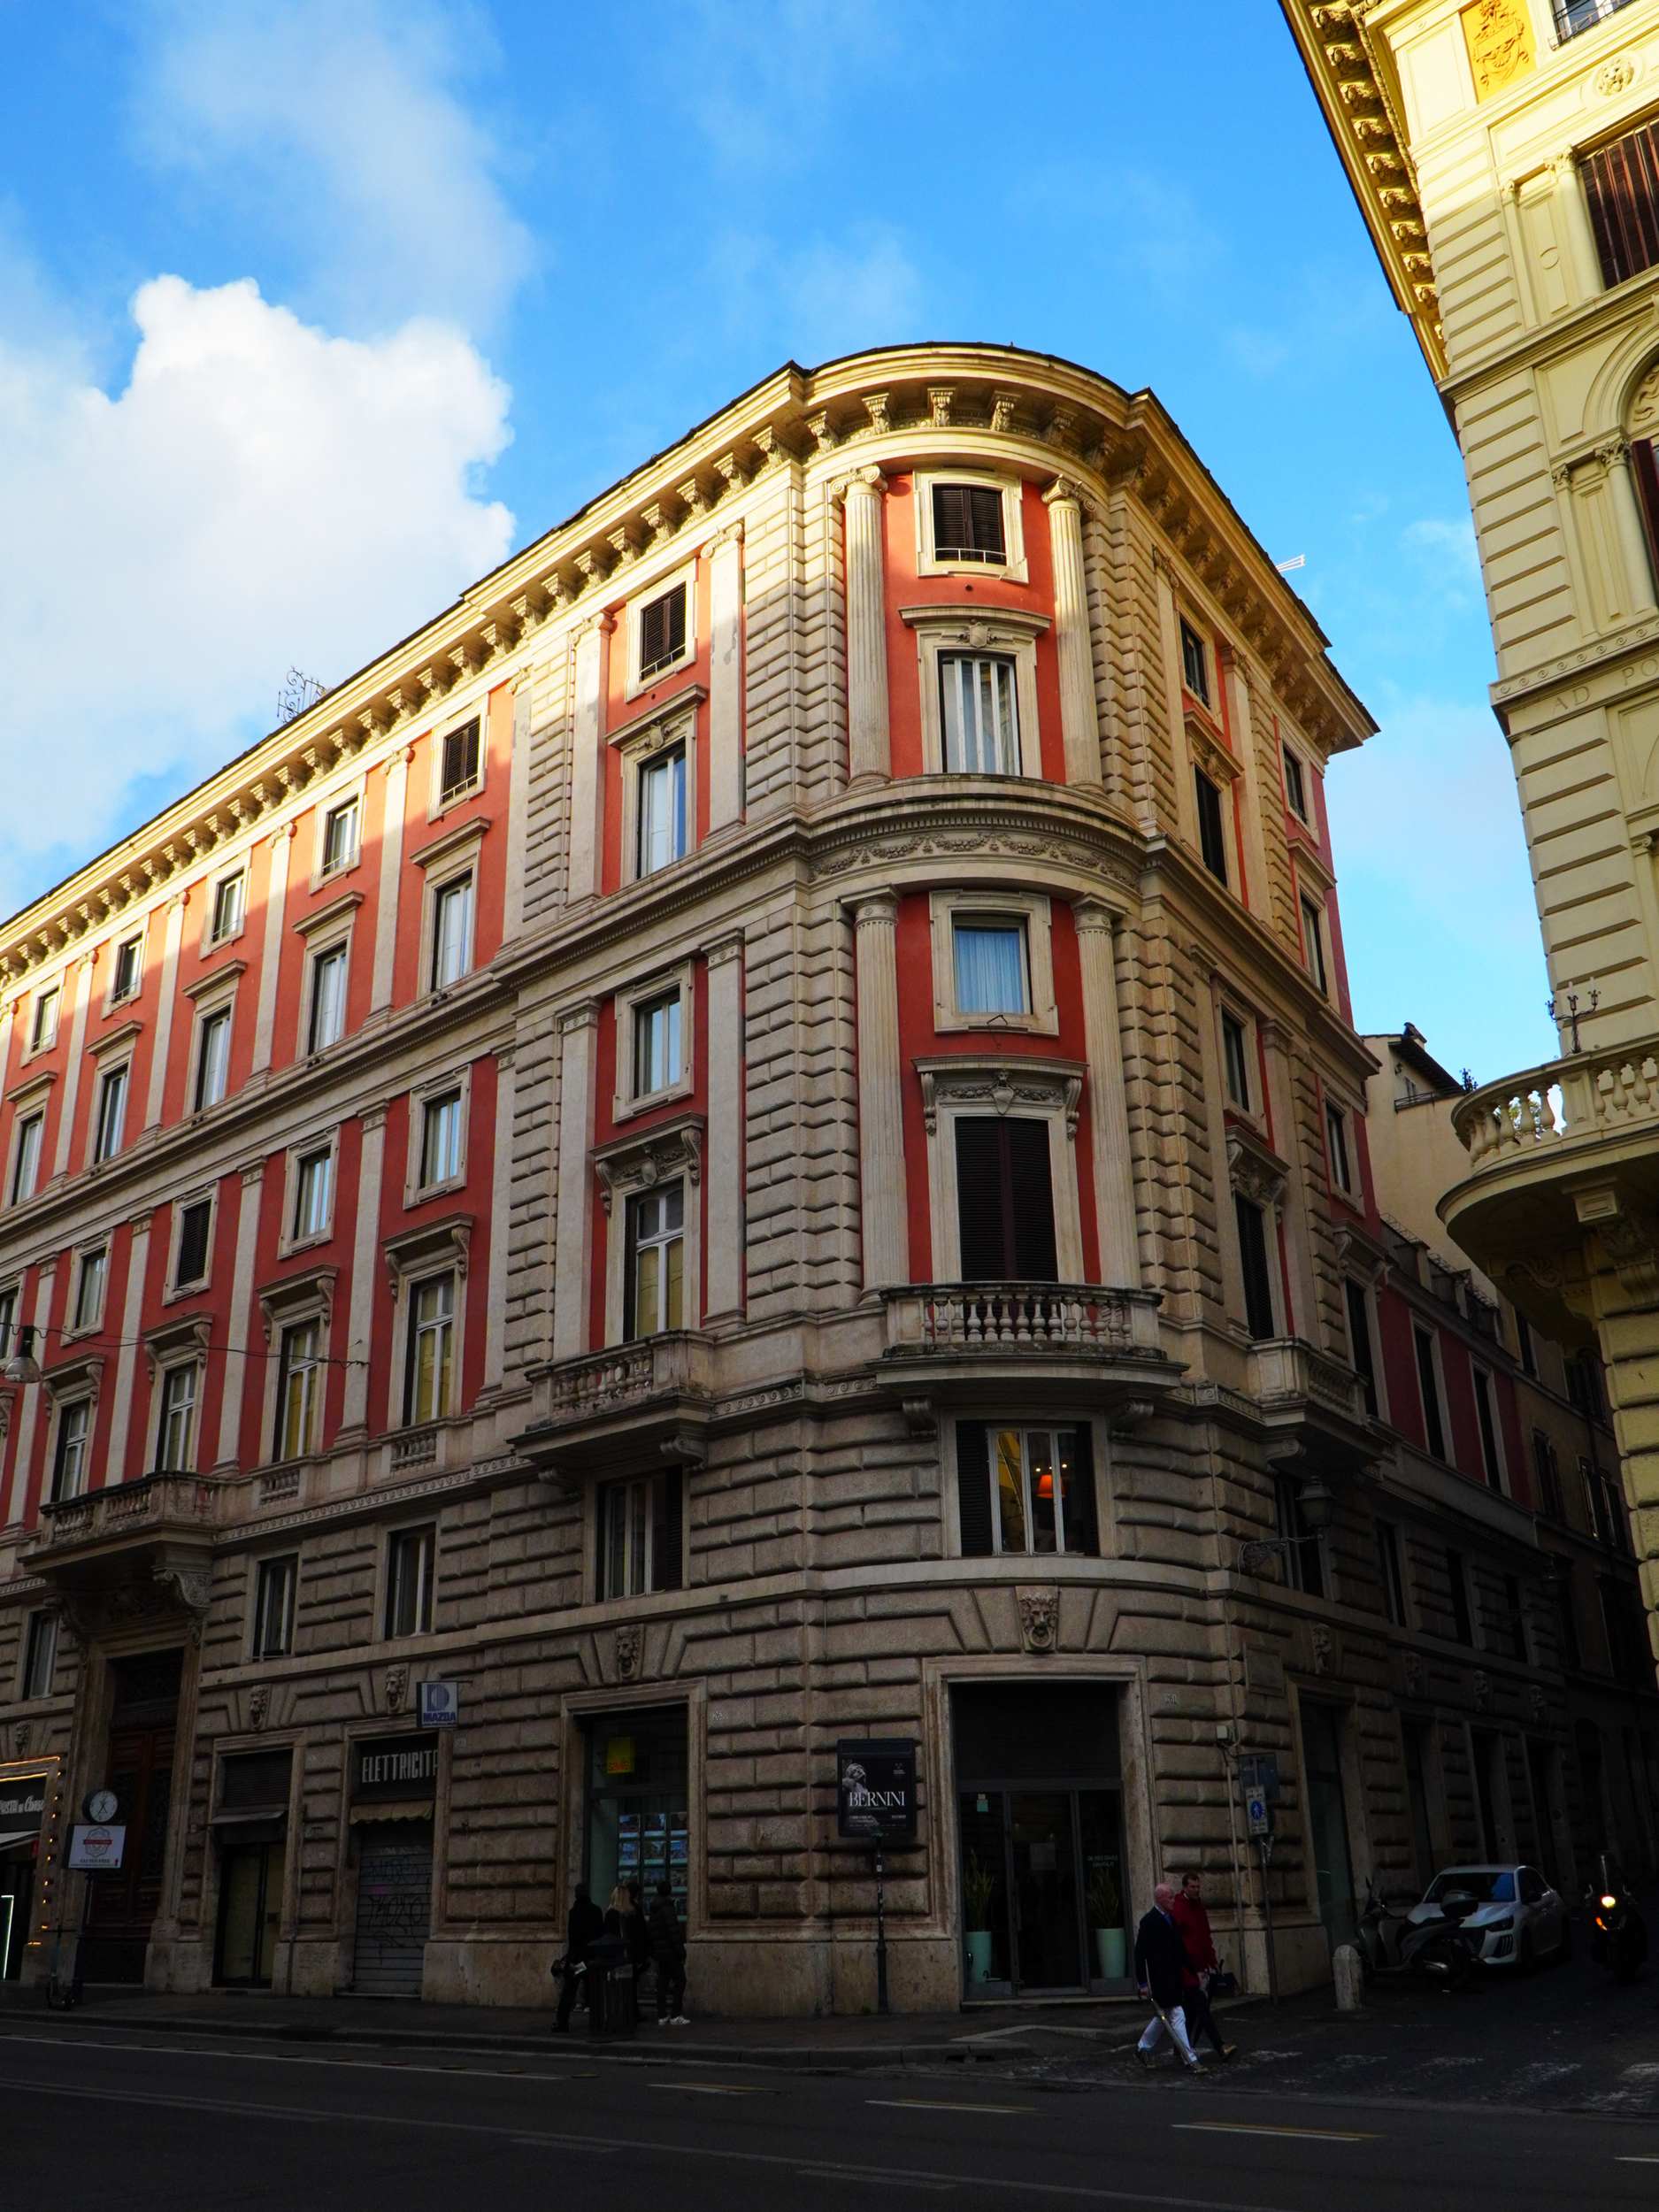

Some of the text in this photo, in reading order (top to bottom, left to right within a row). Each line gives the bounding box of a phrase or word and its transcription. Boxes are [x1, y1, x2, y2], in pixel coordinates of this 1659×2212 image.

[1479, 27, 1515, 54] ANNO
[1552, 686, 1591, 715] AD
[423, 1711, 457, 1723] MAZDA
[849, 1791, 906, 1807] BERNINI
